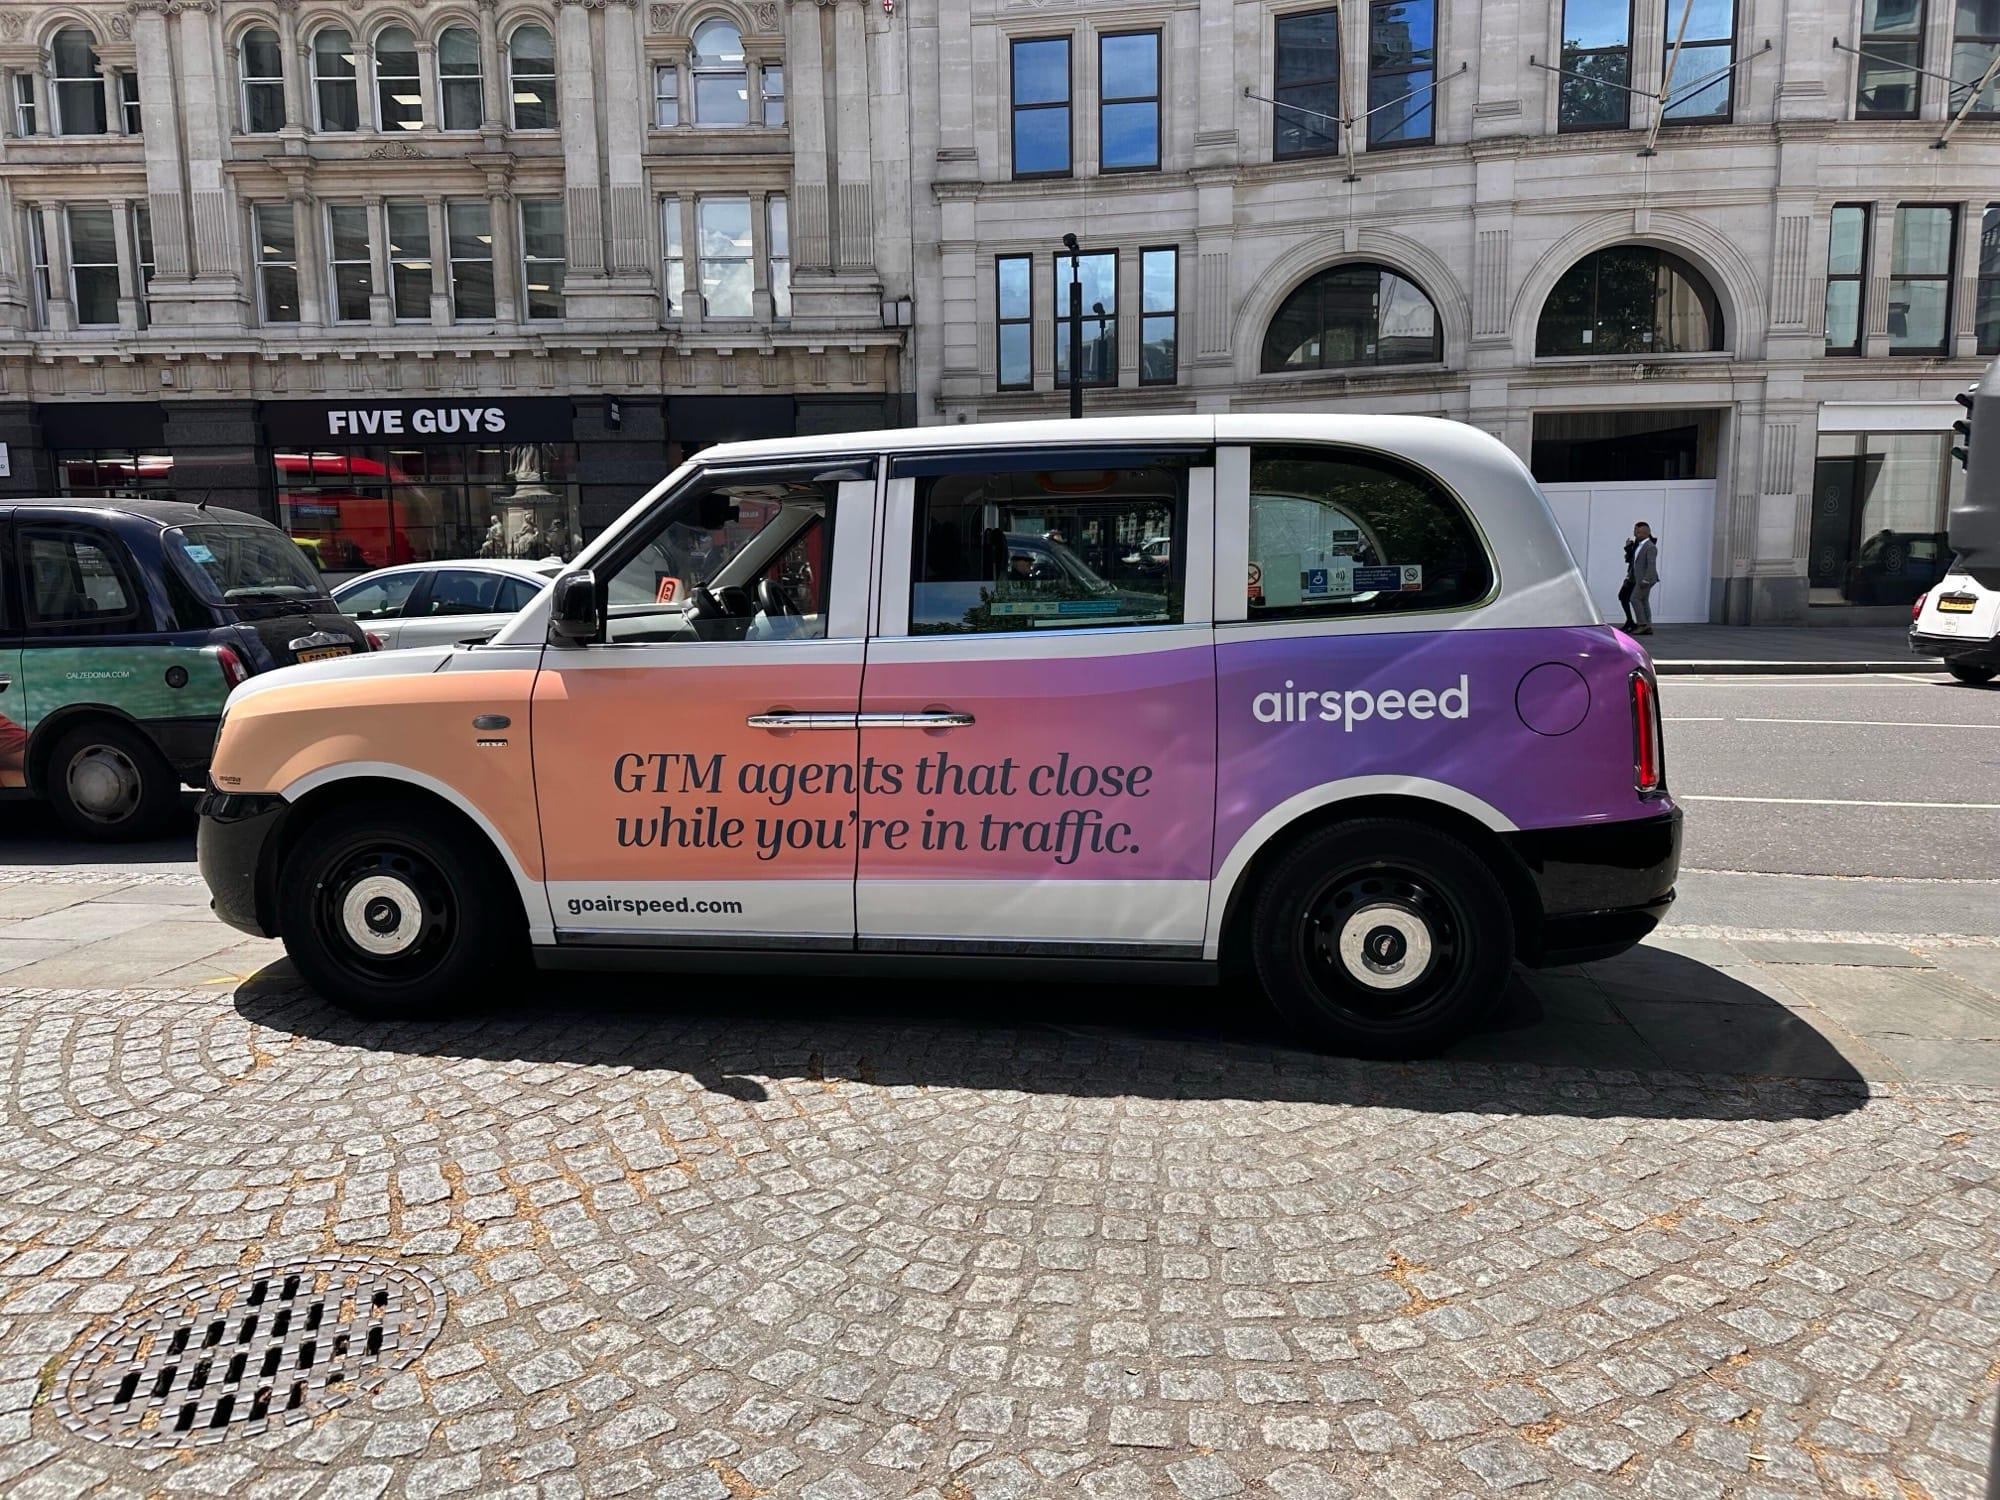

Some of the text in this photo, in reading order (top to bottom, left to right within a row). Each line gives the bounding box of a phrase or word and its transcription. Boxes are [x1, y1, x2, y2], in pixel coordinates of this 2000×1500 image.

[327, 407, 506, 434] FIVE GUYS
[65, 671, 130, 680] CALZEDONIA.COM
[1252, 674, 1469, 732] airspeed
[613, 751, 1153, 806] GTM agents that close
[615, 806, 745, 849] while
[920, 808, 968, 851] in
[979, 809, 1140, 865] traffic.
[567, 895, 743, 916] goairspeed.com
